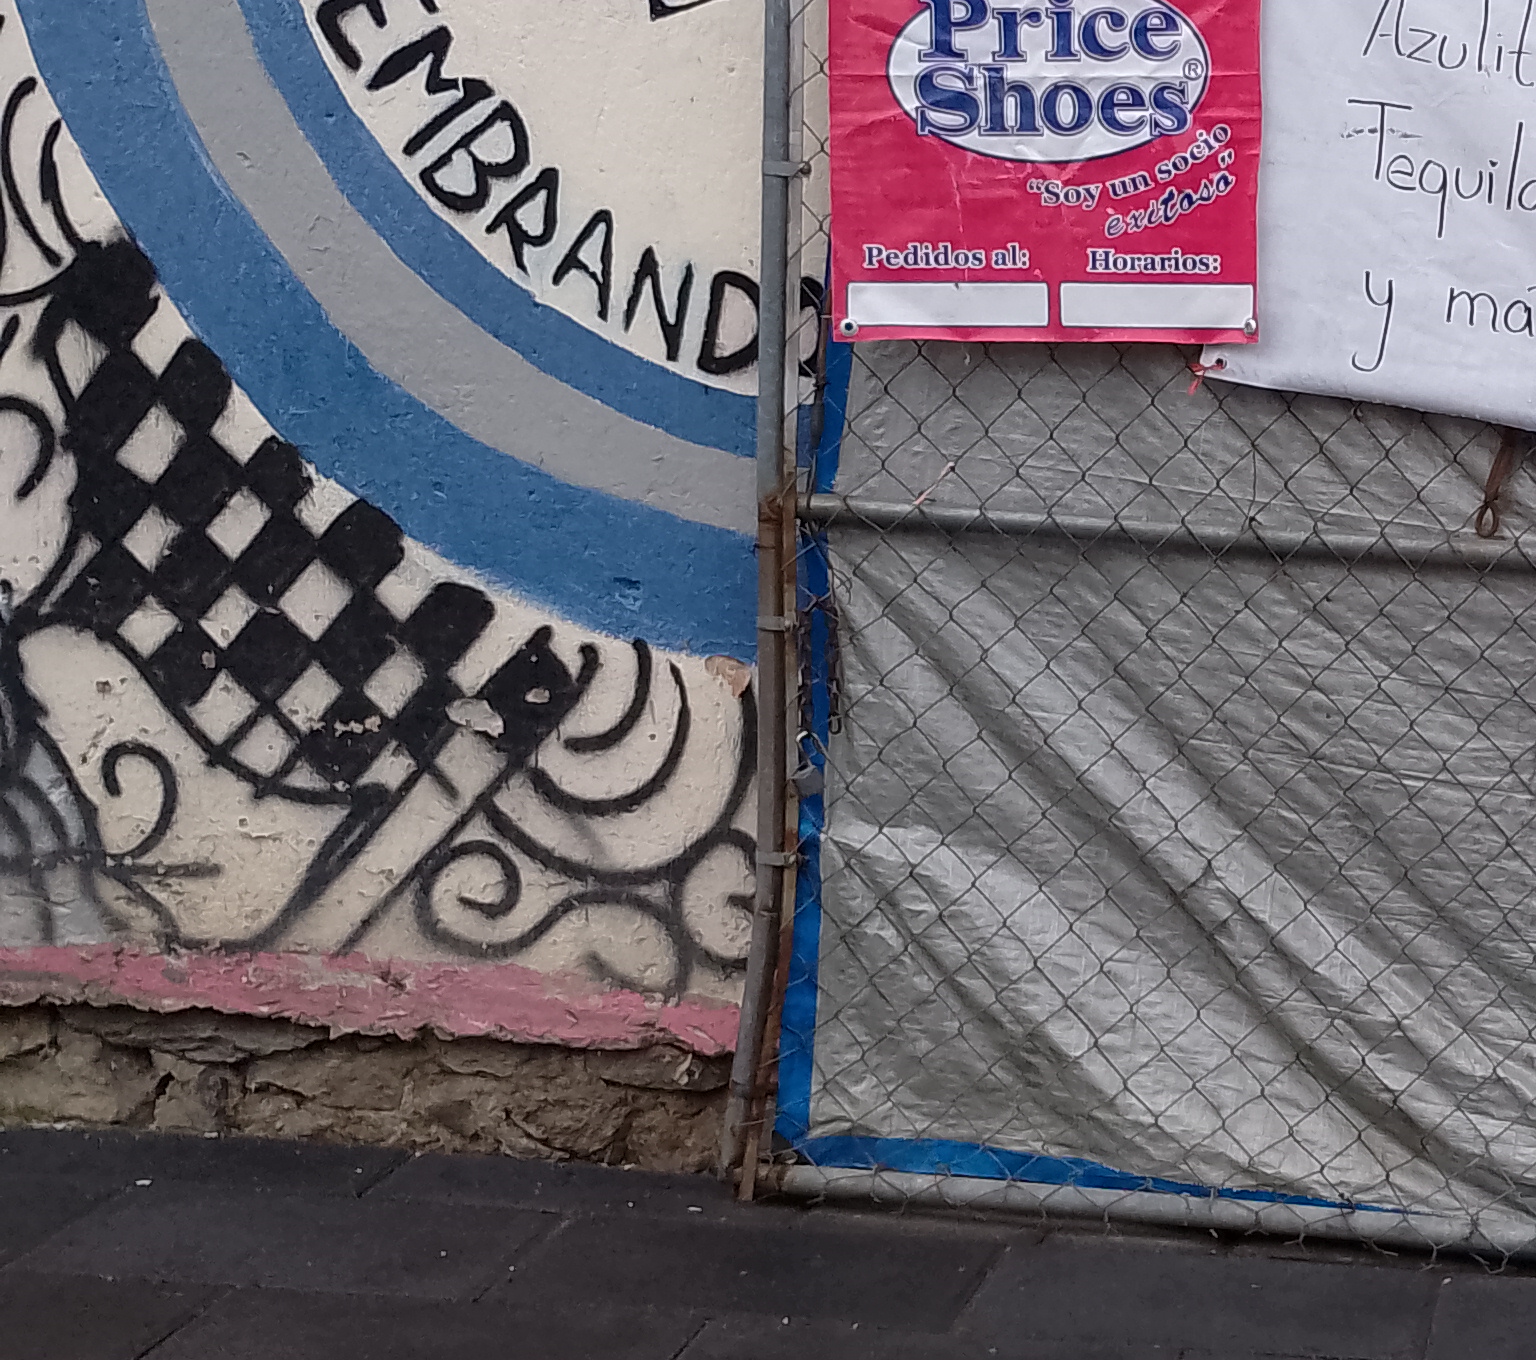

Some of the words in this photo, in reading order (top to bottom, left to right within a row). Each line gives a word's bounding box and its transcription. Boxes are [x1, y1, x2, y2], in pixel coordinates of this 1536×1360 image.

[915, 63, 1192, 137] Shoes
[1107, 170, 1154, 200] un
[1156, 124, 1231, 182] socio
[863, 242, 986, 269] Pedidos
[992, 242, 1030, 269] al:
[1086, 248, 1221, 274] Horarios:
[1350, 269, 1394, 374] y
